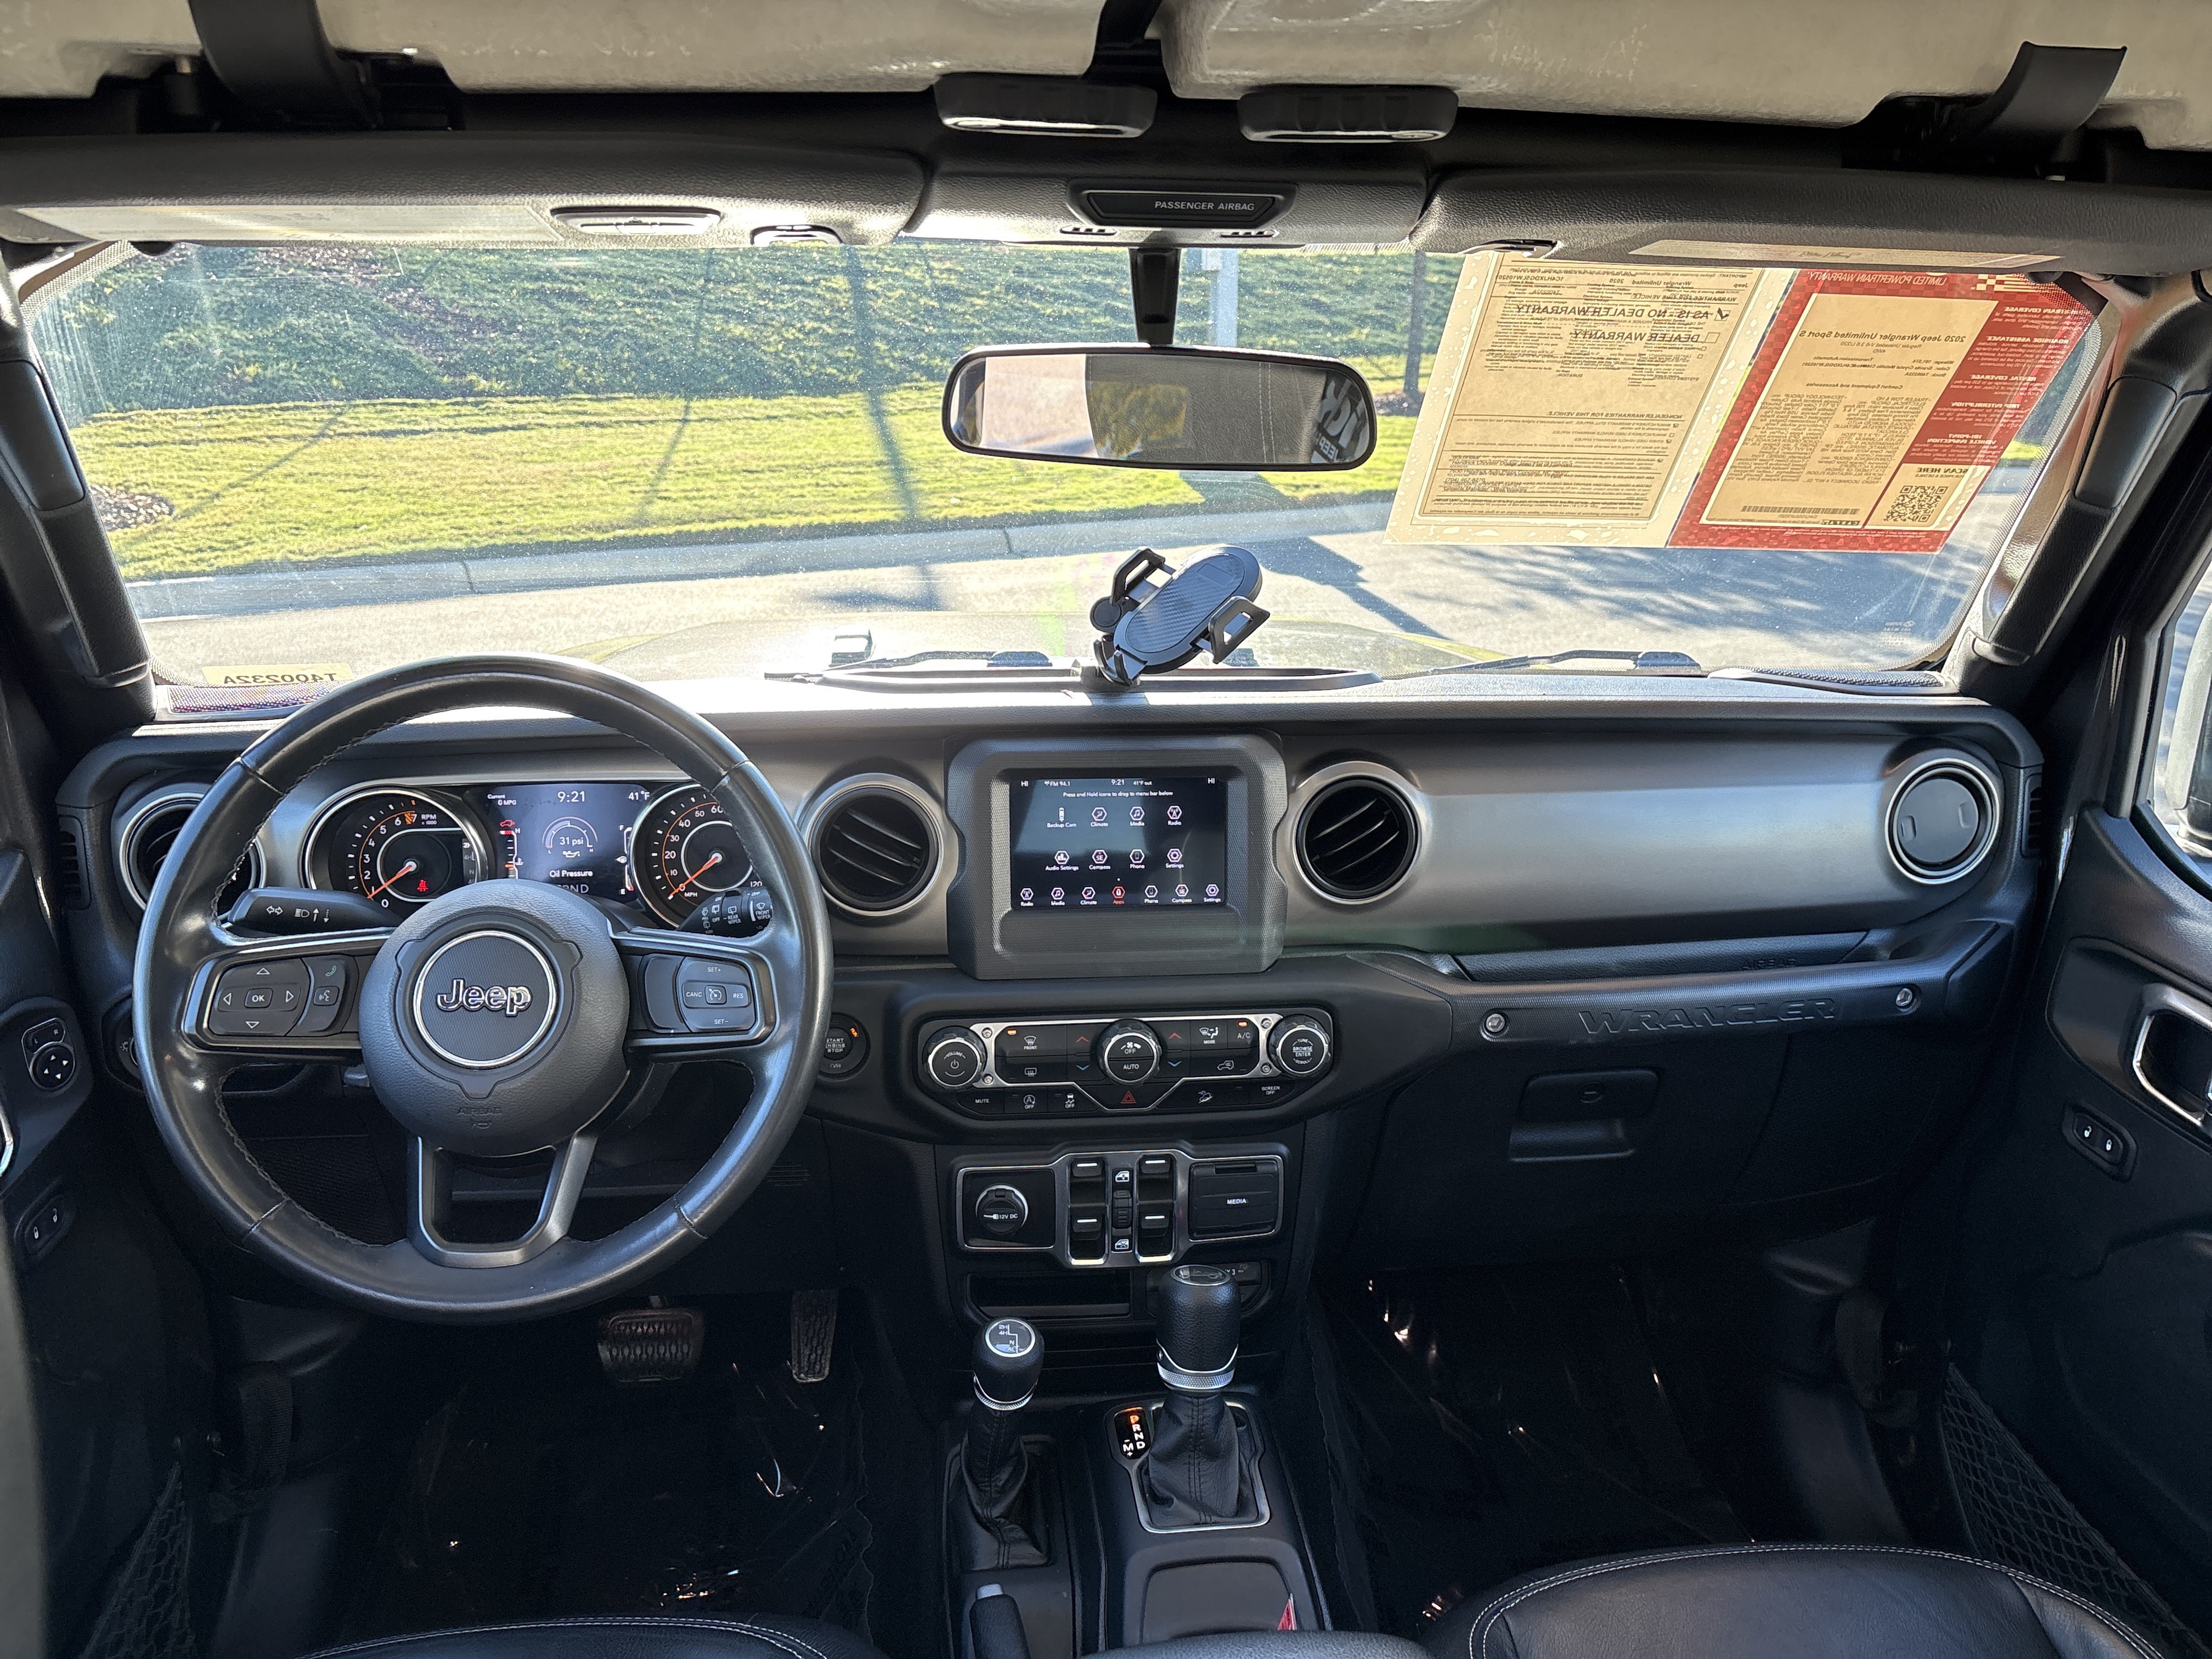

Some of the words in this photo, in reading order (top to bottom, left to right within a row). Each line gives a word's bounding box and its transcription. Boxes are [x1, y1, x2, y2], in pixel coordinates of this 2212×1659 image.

[1155, 201, 1214, 210] PASSENGER
[1218, 202, 1255, 211] AIRBAG
[557, 791, 585, 803] 9:21
[628, 791, 650, 800] 41°F
[711, 805, 724, 814] 60
[394, 816, 402, 826] 6
[411, 814, 417, 823] 7
[380, 826, 387, 834] 5
[368, 838, 375, 847] 4
[559, 837, 570, 845] 31
[572, 837, 584, 848] psi
[363, 854, 370, 863] 3
[664, 851, 676, 859] 20
[364, 870, 371, 880] 2
[679, 883, 685, 891] 0
[381, 899, 389, 908] 0
[437, 978, 531, 1016] Jeep
[1578, 998, 1837, 1035] WRANGLER
[1130, 1415, 1139, 1425] P
[1132, 1424, 1141, 1432] R
[1134, 1432, 1144, 1441] N
[1122, 1442, 1134, 1452] M
[1136, 1441, 1146, 1450] D
